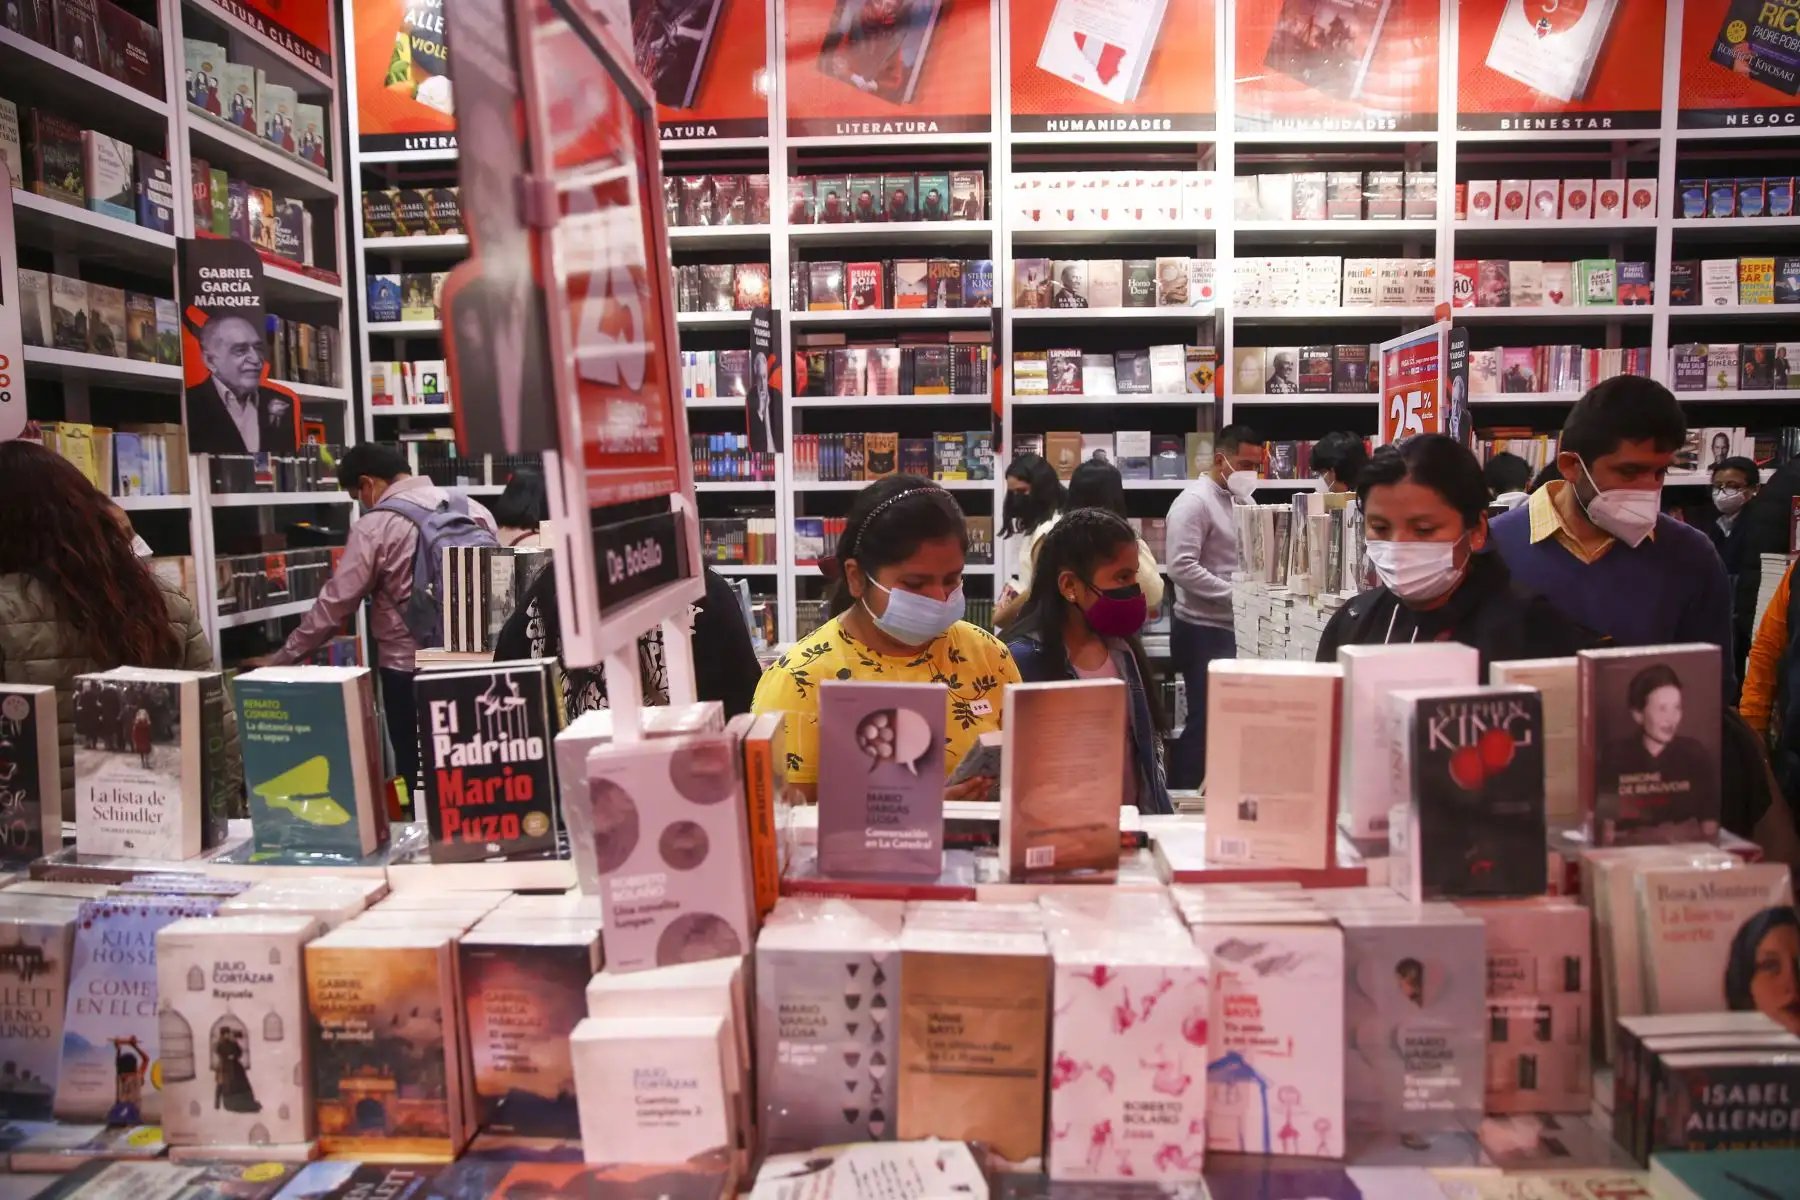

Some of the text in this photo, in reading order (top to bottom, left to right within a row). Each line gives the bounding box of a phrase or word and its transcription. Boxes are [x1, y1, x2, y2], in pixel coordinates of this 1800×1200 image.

[1752, 25, 1779, 44] PADRE
[269, 27, 322, 69] CLÁSICA
[1756, 57, 1795, 82] KIYOSAKI
[1047, 119, 1171, 131] HUMANIDADES
[1272, 117, 1396, 130] HUMANIDADES
[1500, 117, 1612, 129] BIENESTAR
[1726, 113, 1795, 125] NEGOC
[836, 121, 938, 133] LITERATURA
[199, 267, 253, 279] GABRIEL
[929, 264, 960, 279] KING
[1740, 264, 1774, 272] REPEN
[851, 277, 877, 285] ROJA
[1128, 279, 1150, 287] Homo
[1740, 274, 1761, 282] SAR
[202, 281, 251, 293] GARCÍA
[1130, 286, 1148, 295] Deus
[194, 293, 260, 307] MÁRQUEZ
[1391, 391, 1431, 442] 25 %
[606, 537, 662, 585] De Bolsillo
[244, 699, 279, 709] RENATO
[245, 709, 289, 720] CISNEROS
[429, 700, 459, 735] El
[246, 722, 311, 735] La distancia que
[1429, 711, 1532, 751] KING
[248, 733, 290, 744] nos separa
[433, 732, 543, 768] Padrino
[436, 766, 534, 807] Mario
[1635, 780, 1690, 795] BEAUVOIR
[90, 787, 165, 806] La lista de
[867, 792, 903, 803] MARIO
[867, 803, 910, 814] VARGAS
[93, 806, 163, 824] Schindler
[440, 807, 520, 846] Puzo
[865, 827, 928, 839] Conversación
[865, 838, 932, 850] en La Catedral
[213, 961, 246, 973] JULIO
[213, 971, 274, 984] CORTÁZAR
[318, 979, 362, 990] GABRIEL
[213, 989, 253, 1000] Rayuela
[318, 990, 360, 1001] GARCÍA
[76, 999, 131, 1016] EN EL
[779, 1004, 820, 1014] MARIO
[779, 1015, 828, 1026] VARGAS
[779, 1027, 817, 1038] LLOSA
[1224, 1023, 1237, 1032] Yo
[322, 1029, 374, 1041] de soledad
[1405, 1037, 1447, 1047] MARIO
[635, 1095, 680, 1105] Cuentos
[1702, 1083, 1790, 1106] ISABEL
[636, 1107, 691, 1118] completos
[1123, 1101, 1182, 1112] ROBERTO
